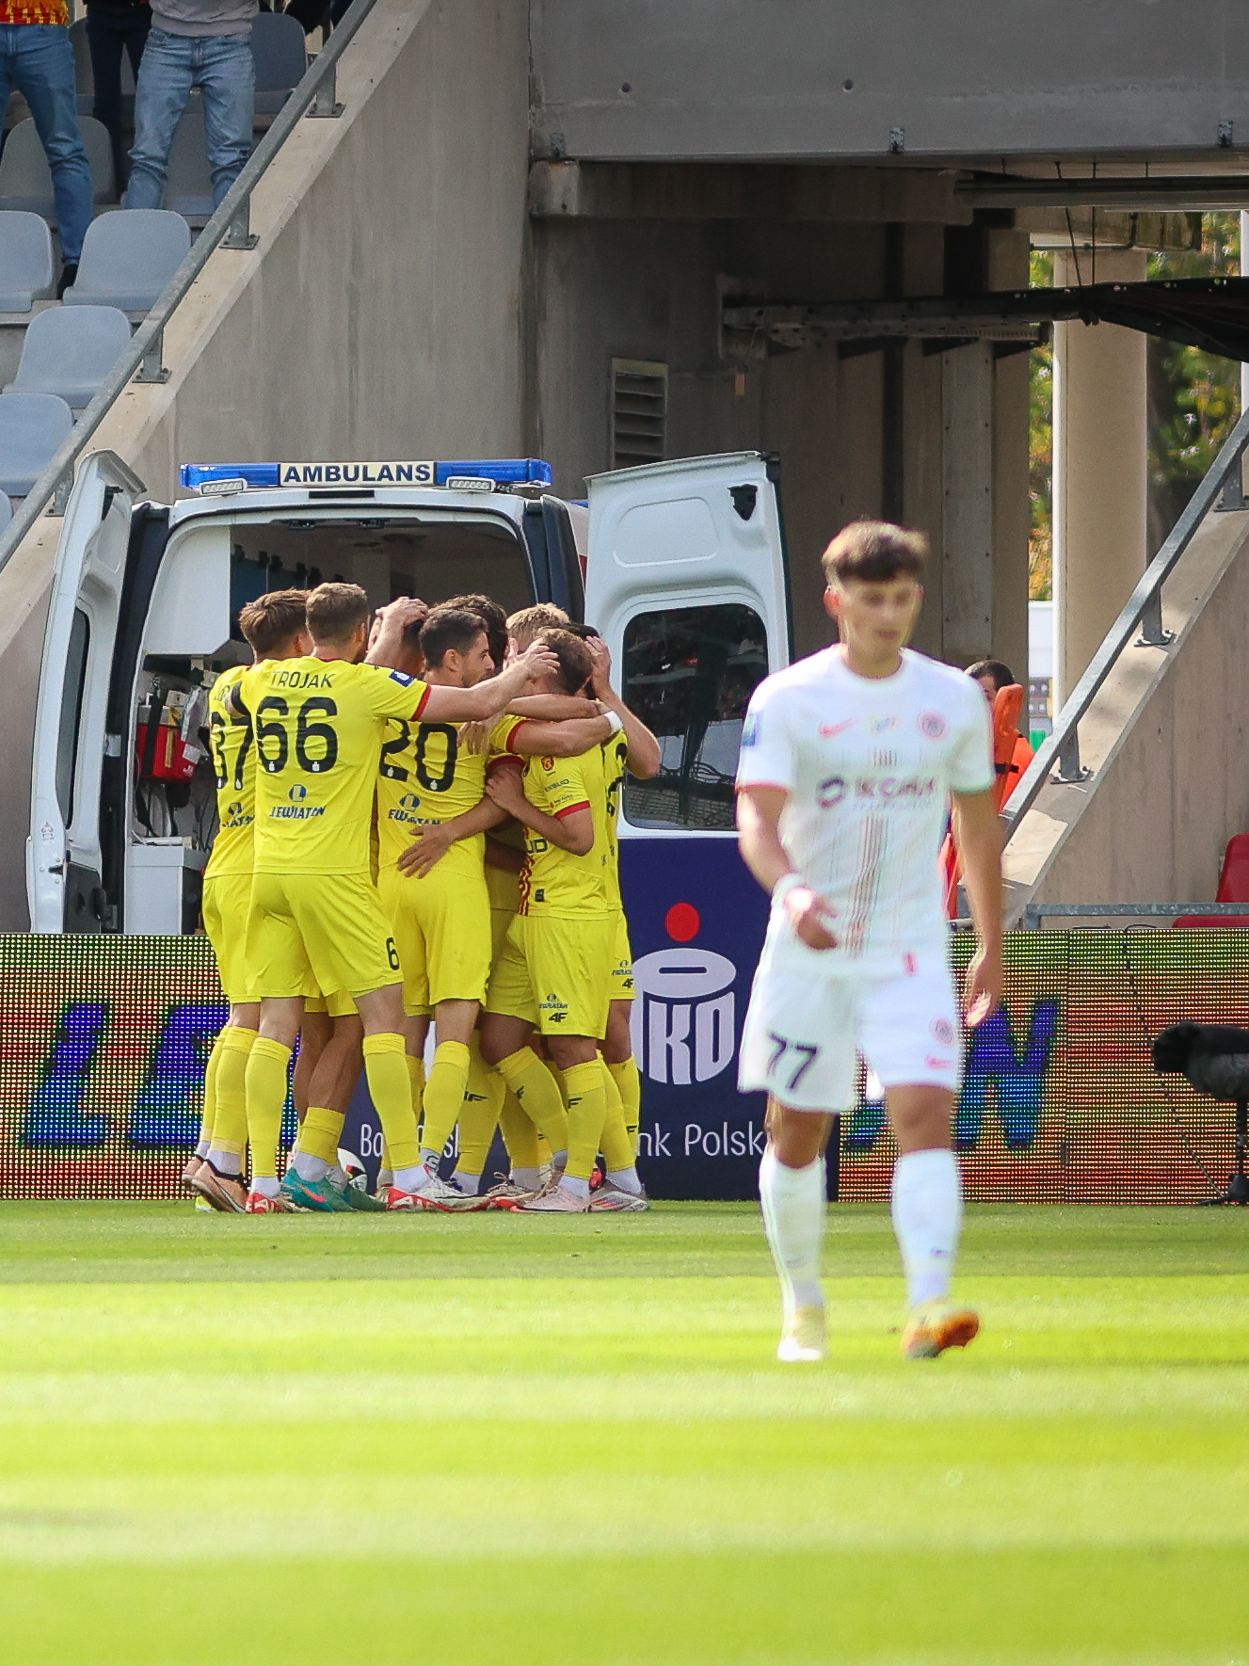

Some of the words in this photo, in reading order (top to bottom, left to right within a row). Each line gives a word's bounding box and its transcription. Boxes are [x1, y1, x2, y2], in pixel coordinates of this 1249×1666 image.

[283, 463, 431, 483] AMBULANS
[271, 671, 336, 689] TROJAK
[257, 696, 338, 773] 66
[379, 717, 458, 792] 20
[549, 1012, 568, 1023] 4F
[767, 1032, 820, 1091] 77
[685, 1122, 765, 1157] Polsk
